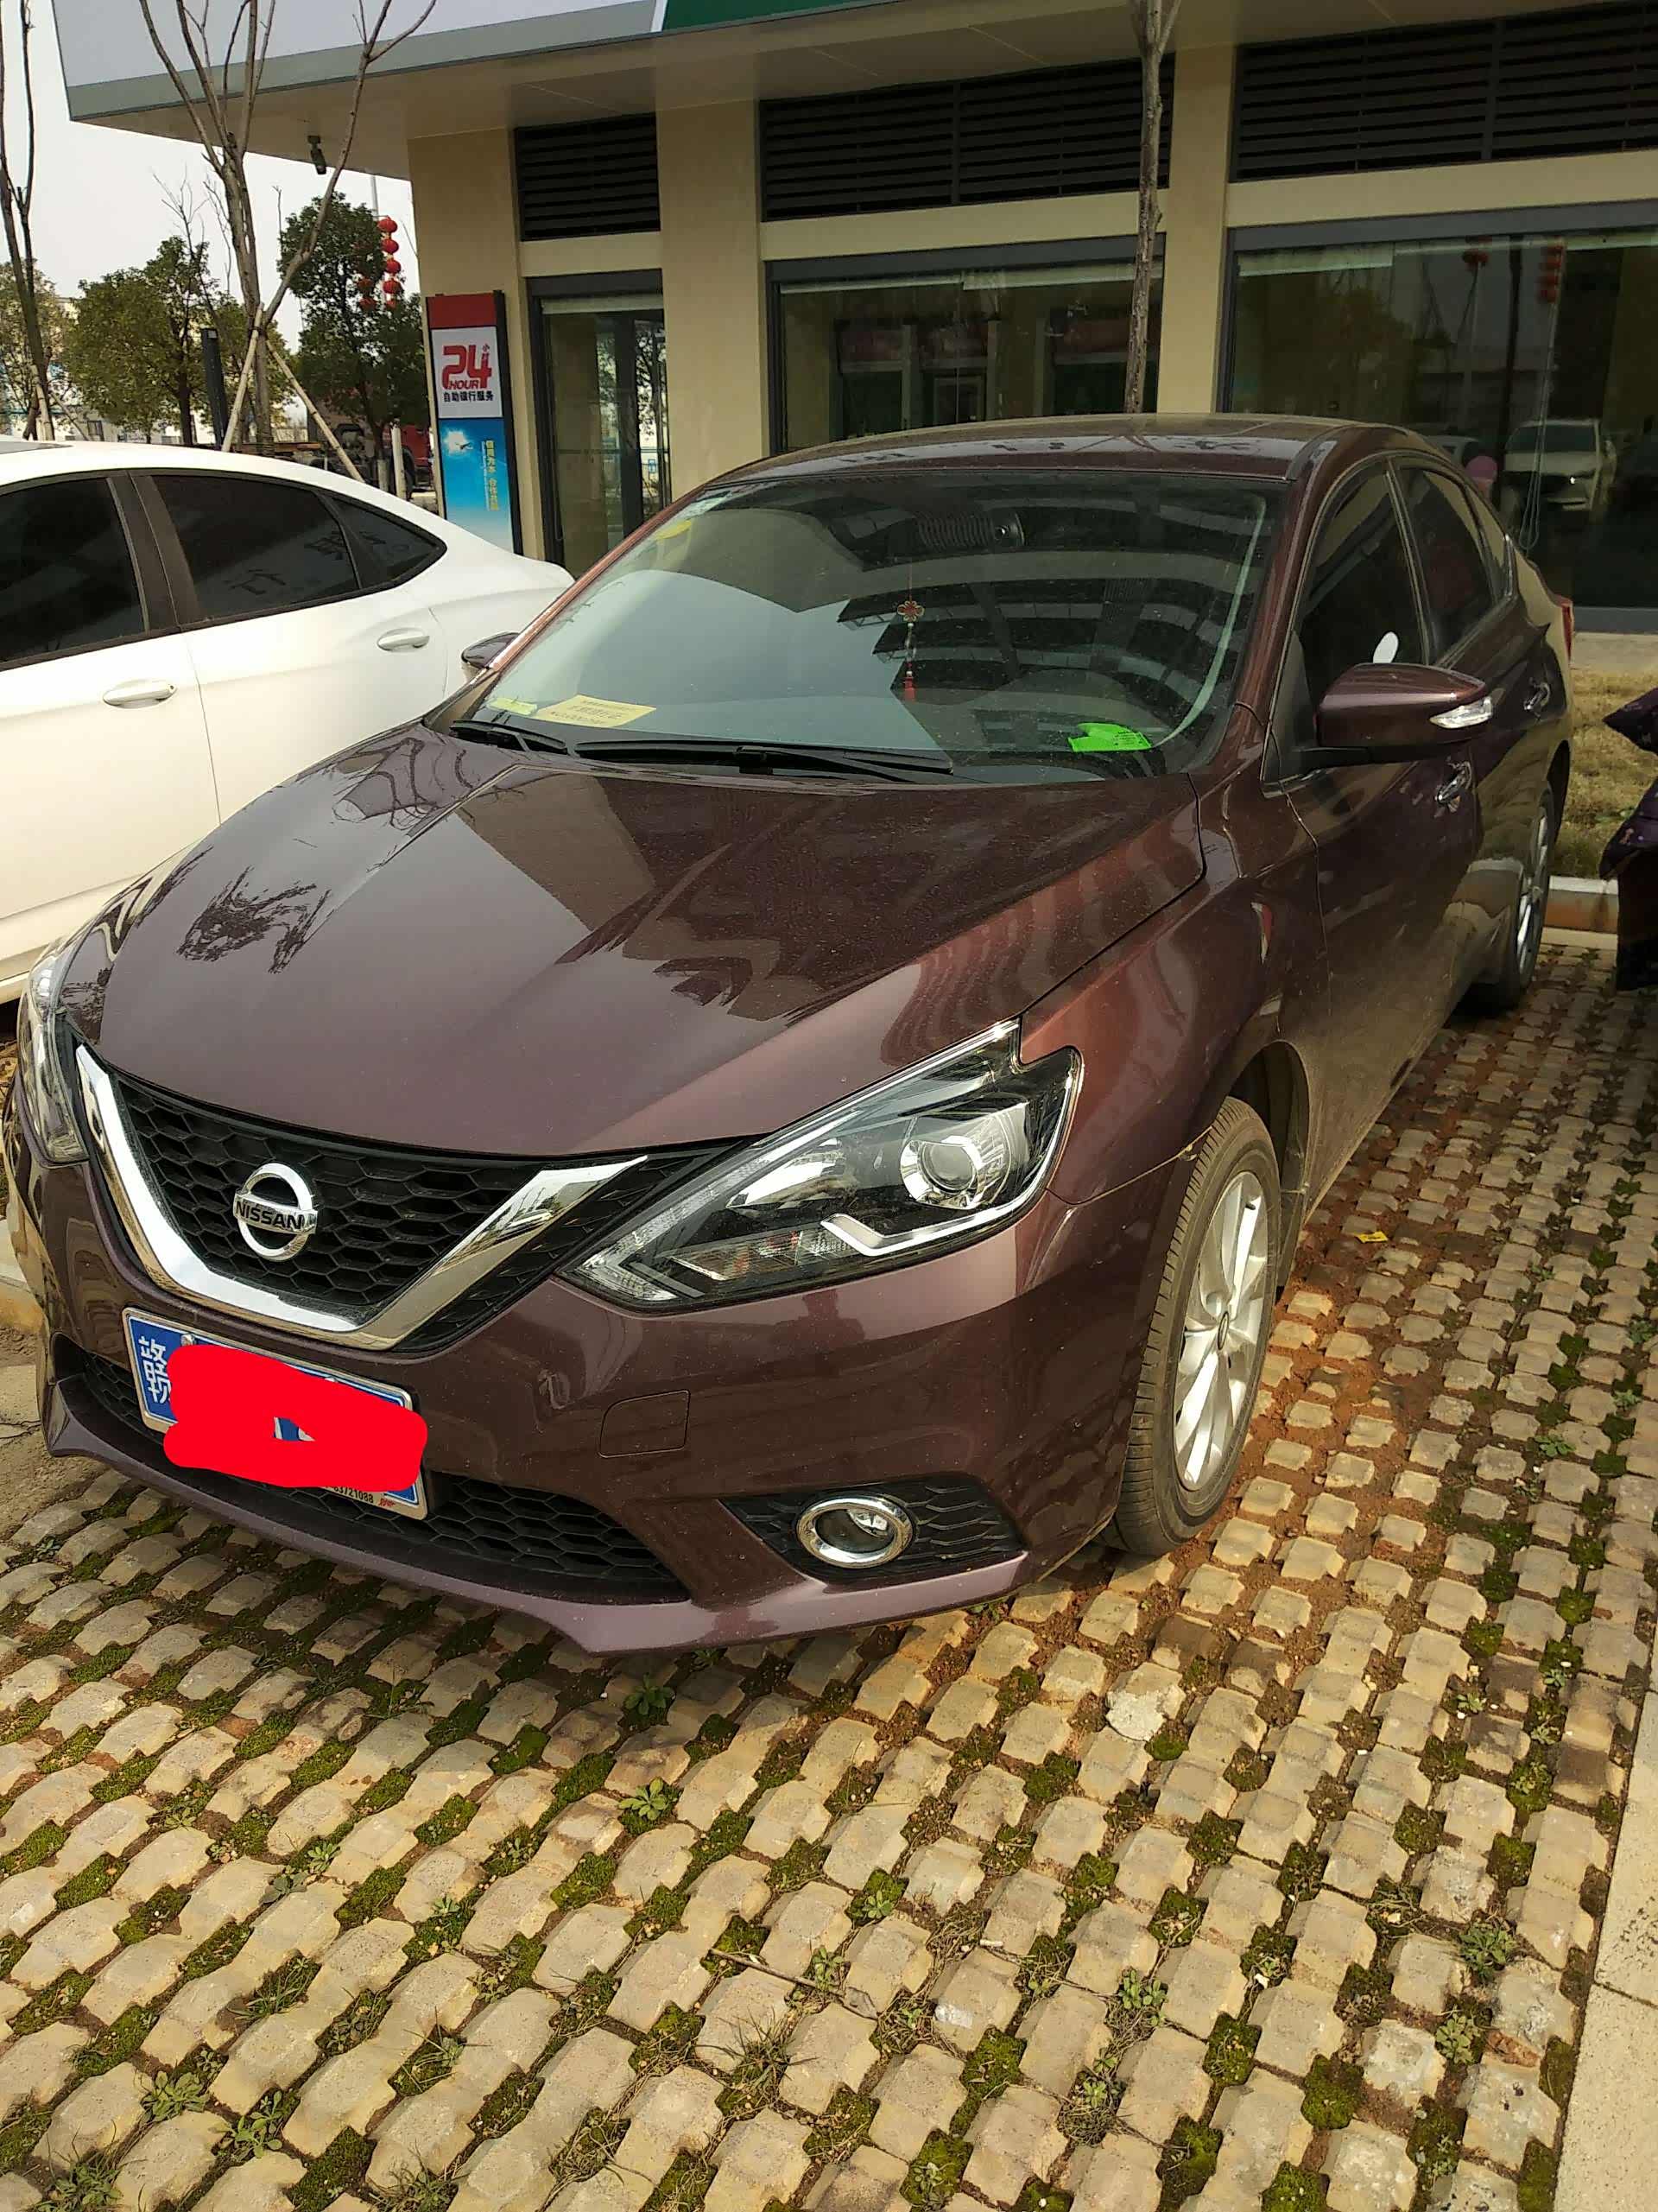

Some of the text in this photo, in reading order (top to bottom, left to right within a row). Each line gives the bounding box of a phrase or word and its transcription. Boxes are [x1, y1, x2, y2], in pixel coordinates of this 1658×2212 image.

[442, 345, 492, 390] 24
[449, 380, 478, 390] HOUR
[443, 390, 494, 402] 自助银行服务
[236, 1201, 305, 1230] NISSAN
